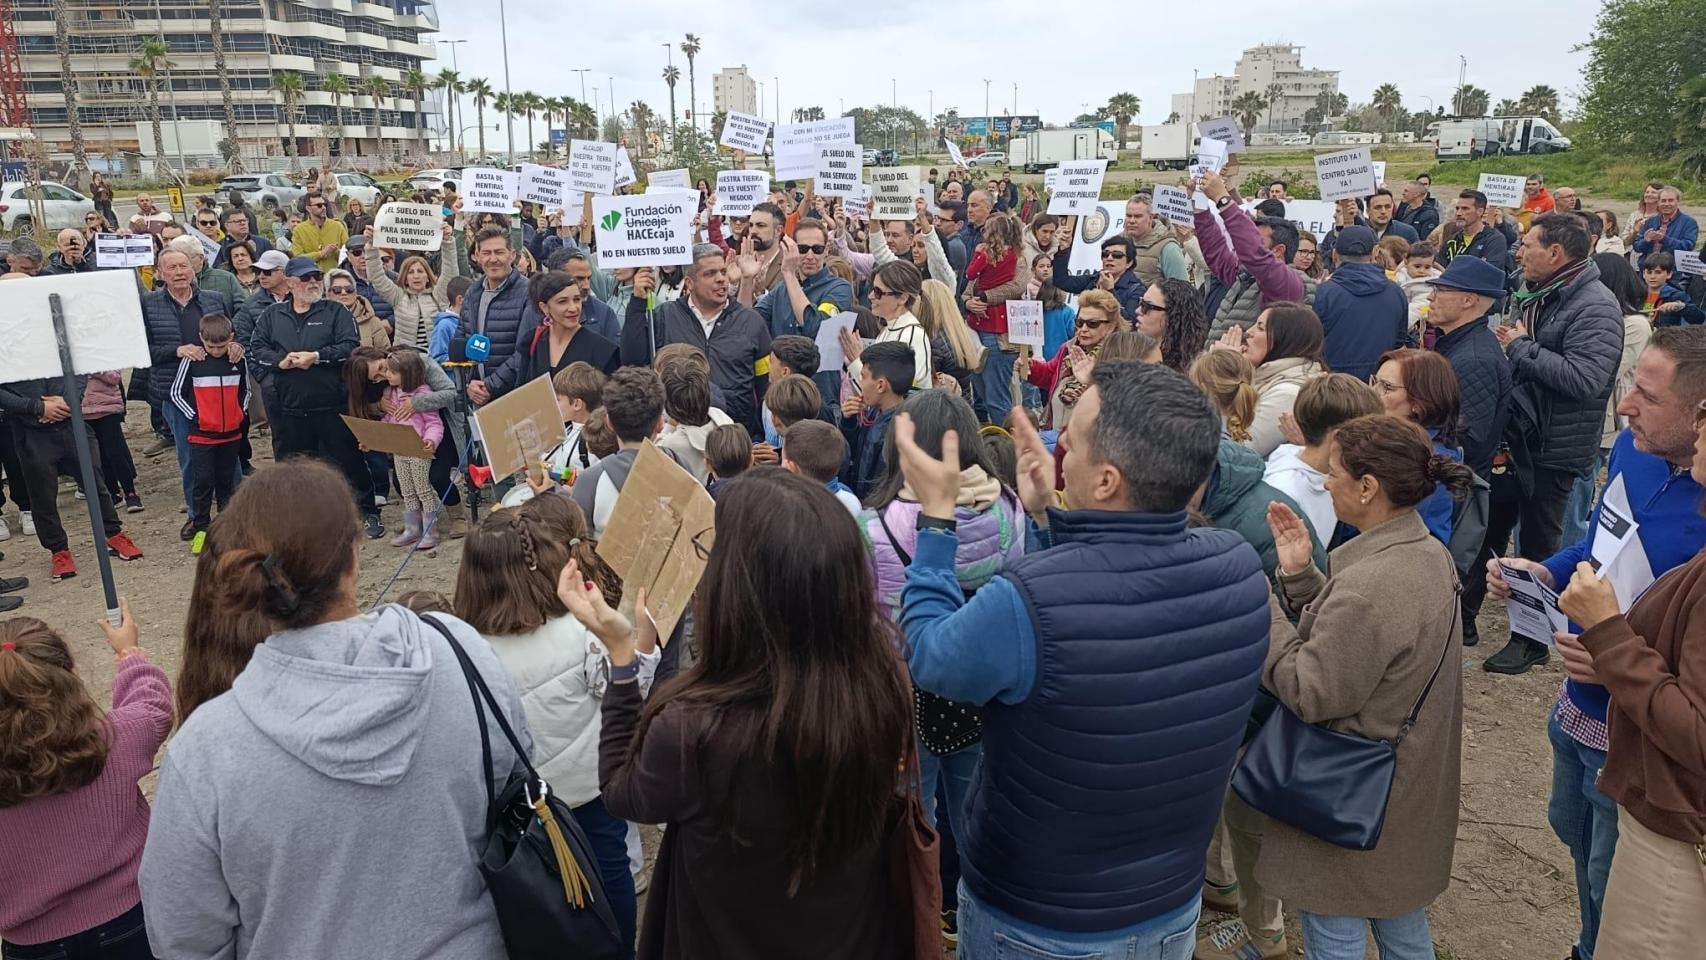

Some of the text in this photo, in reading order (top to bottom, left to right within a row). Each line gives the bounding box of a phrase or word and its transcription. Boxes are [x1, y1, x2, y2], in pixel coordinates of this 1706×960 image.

[731, 115, 750, 123] NUESTRA
[1319, 155, 1348, 166] INSTITUTO
[832, 172, 856, 180] SERVICIOS
[1321, 170, 1345, 180] CENTRO
[1346, 166, 1368, 175] SALUD
[532, 177, 564, 187] DOTACIONE
[538, 187, 557, 195] MENOS
[1169, 199, 1187, 207] BARRIO
[625, 204, 682, 217] Fundación
[1171, 207, 1194, 216] SERVICIO
[395, 217, 420, 225] BARRIO
[626, 216, 667, 228] Unicaja
[400, 228, 434, 236] SERVICIOS
[1311, 221, 1326, 234] EL
[627, 228, 674, 241] HACEcaja
[627, 248, 660, 256] NUESTRO
[663, 246, 686, 254] SUELO
